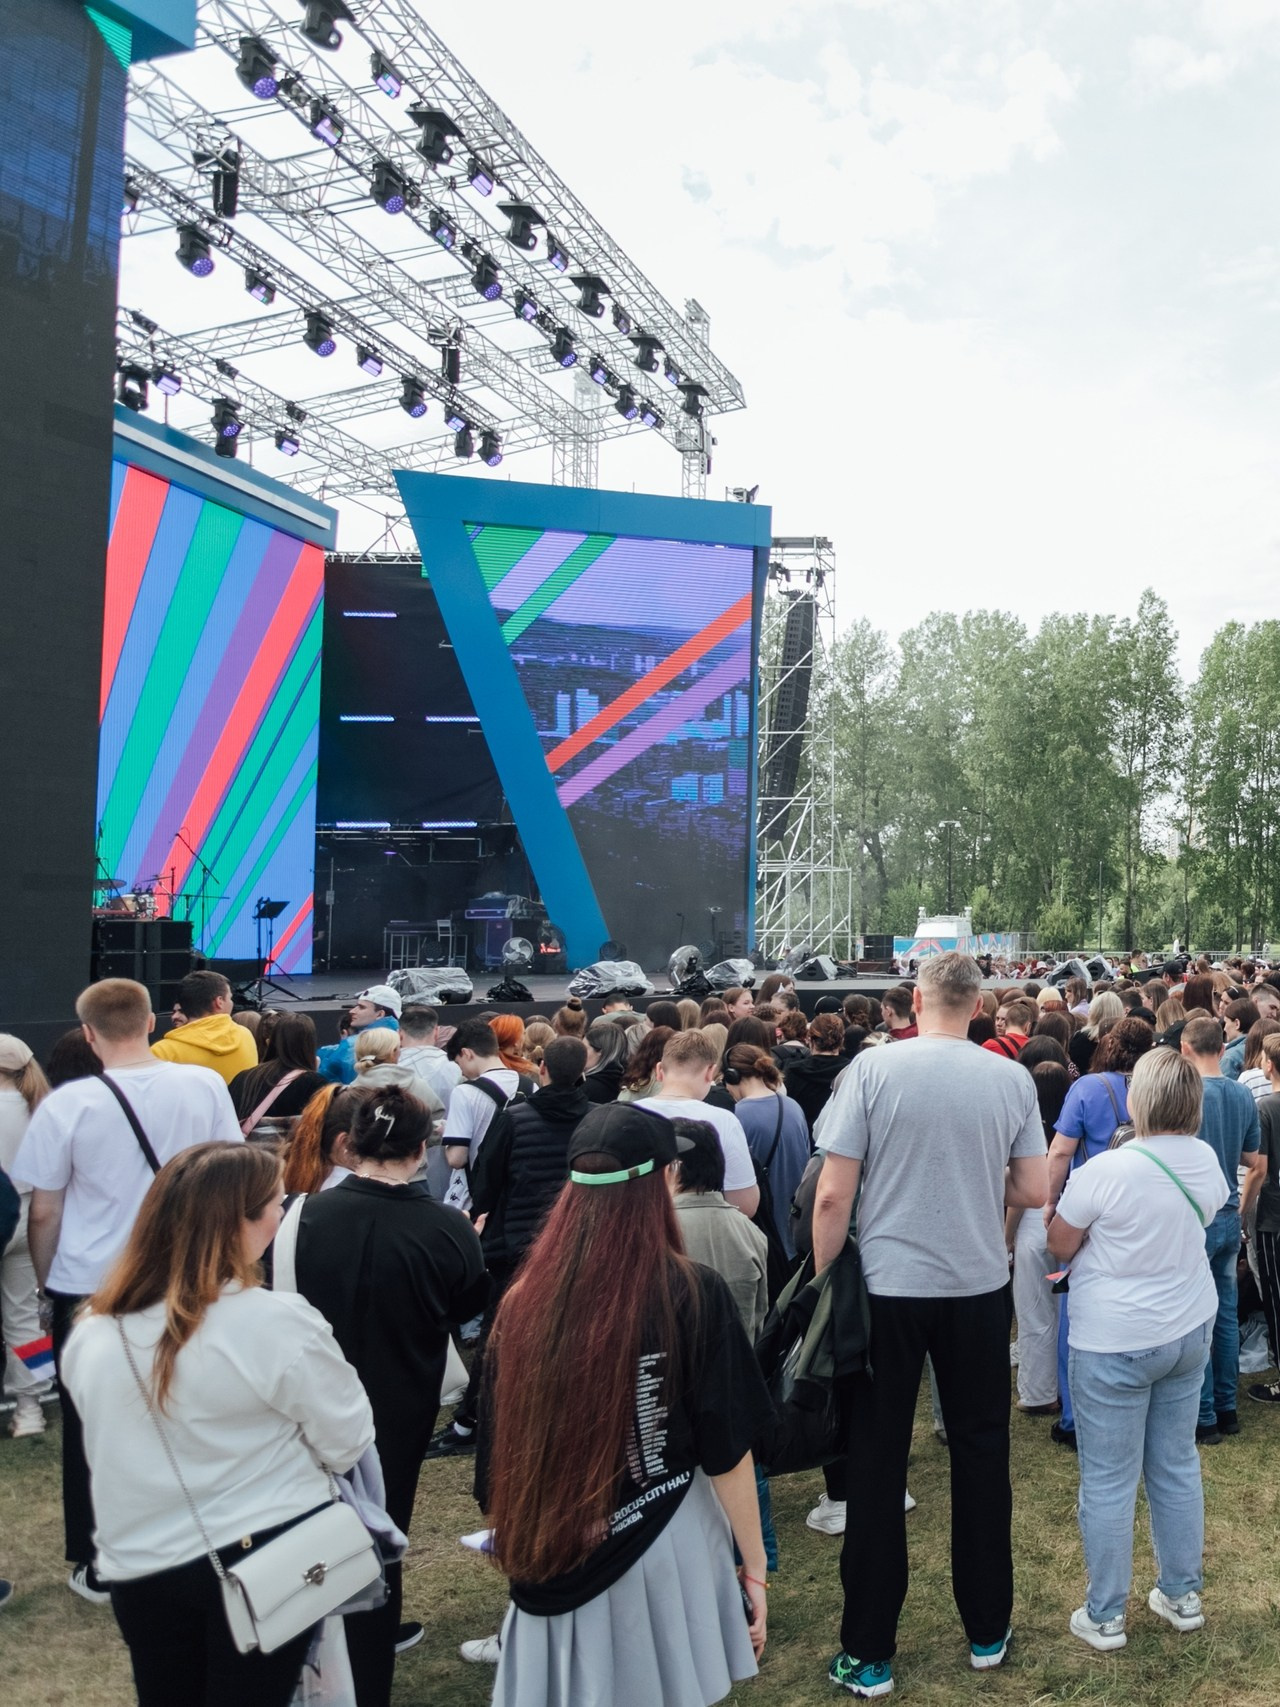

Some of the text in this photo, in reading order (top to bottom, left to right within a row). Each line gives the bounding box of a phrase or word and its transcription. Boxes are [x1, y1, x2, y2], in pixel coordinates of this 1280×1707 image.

[608, 1495, 646, 1525] CROCUS
[645, 1483, 666, 1502] CITY
[611, 1510, 643, 1536] МОСКВА
